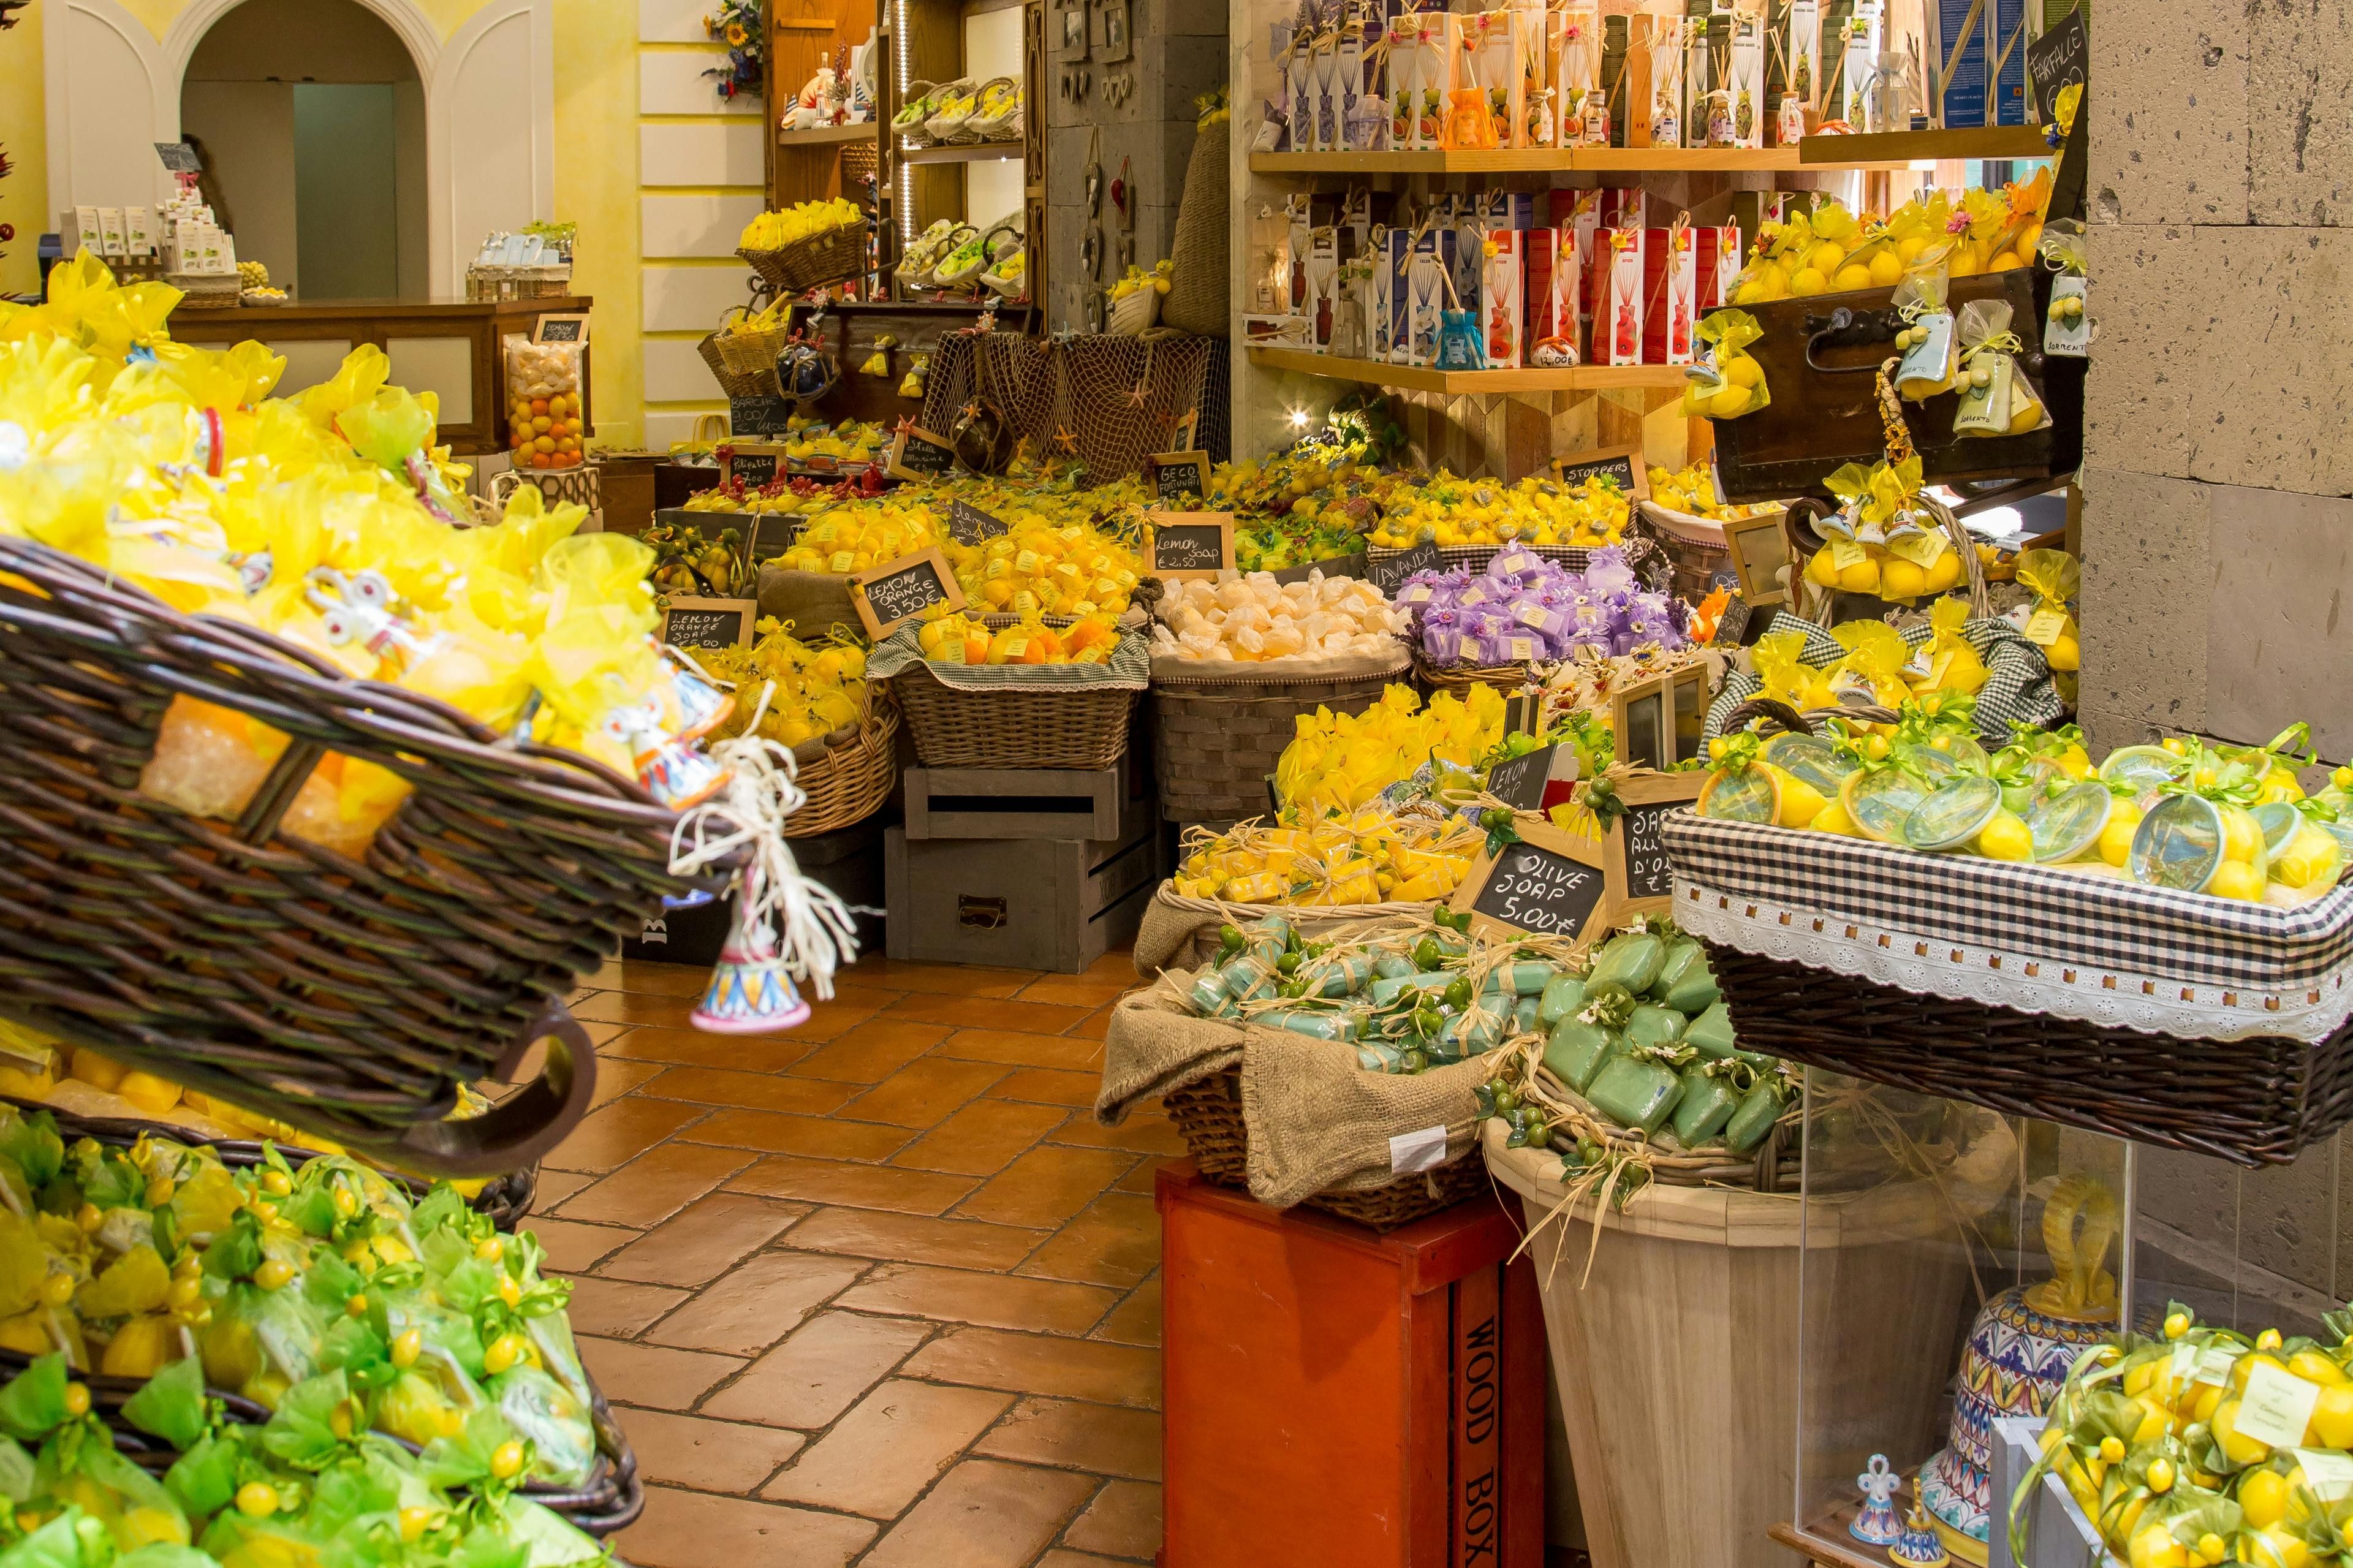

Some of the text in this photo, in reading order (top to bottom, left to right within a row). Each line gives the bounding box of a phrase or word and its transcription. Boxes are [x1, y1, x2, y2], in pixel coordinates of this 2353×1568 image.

[2048, 341, 2086, 351] SORRENT
[732, 398, 777, 408] BARCHE
[1567, 463, 1627, 480] STOPPERS
[1156, 533, 1199, 551] Lemon
[1376, 546, 1436, 586] LAVANDA
[868, 572, 916, 601] LEMON
[879, 579, 934, 606] ORANGE
[670, 623, 719, 631] ORANGE
[672, 613, 726, 624] LEMON
[672, 631, 708, 642] SOAP
[1487, 754, 1530, 793] LEMON
[1516, 855, 1590, 890] OLIVE
[1495, 874, 1565, 901] SOAP
[1464, 1314, 1496, 1568] WOOD BOX
